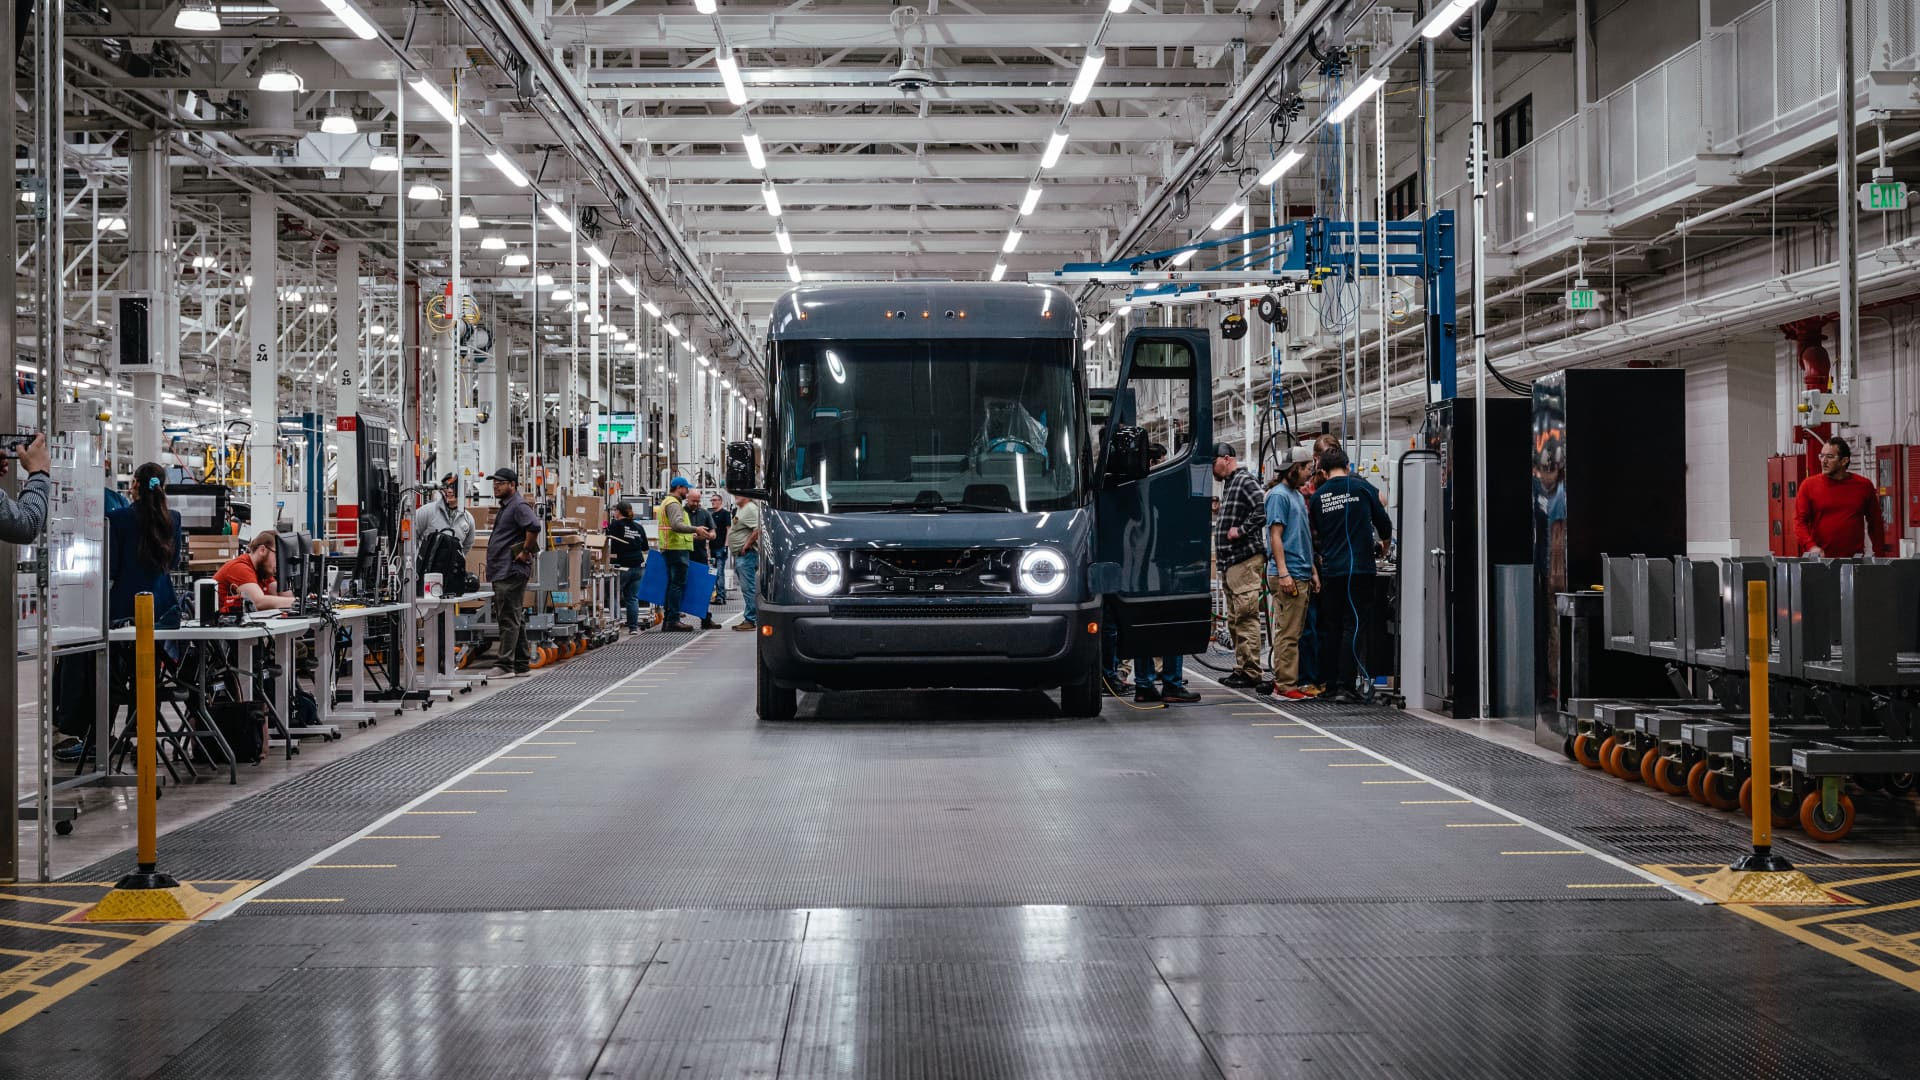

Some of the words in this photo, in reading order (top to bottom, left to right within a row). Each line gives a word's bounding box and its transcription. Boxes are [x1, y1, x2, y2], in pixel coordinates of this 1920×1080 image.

[1870, 183, 1901, 208] EXIT
[1571, 290, 1594, 308] EXIT
[258, 344, 267, 352] C
[256, 354, 268, 362] 24
[341, 378, 352, 386] 25
[1331, 493, 1350, 501] WORLD
